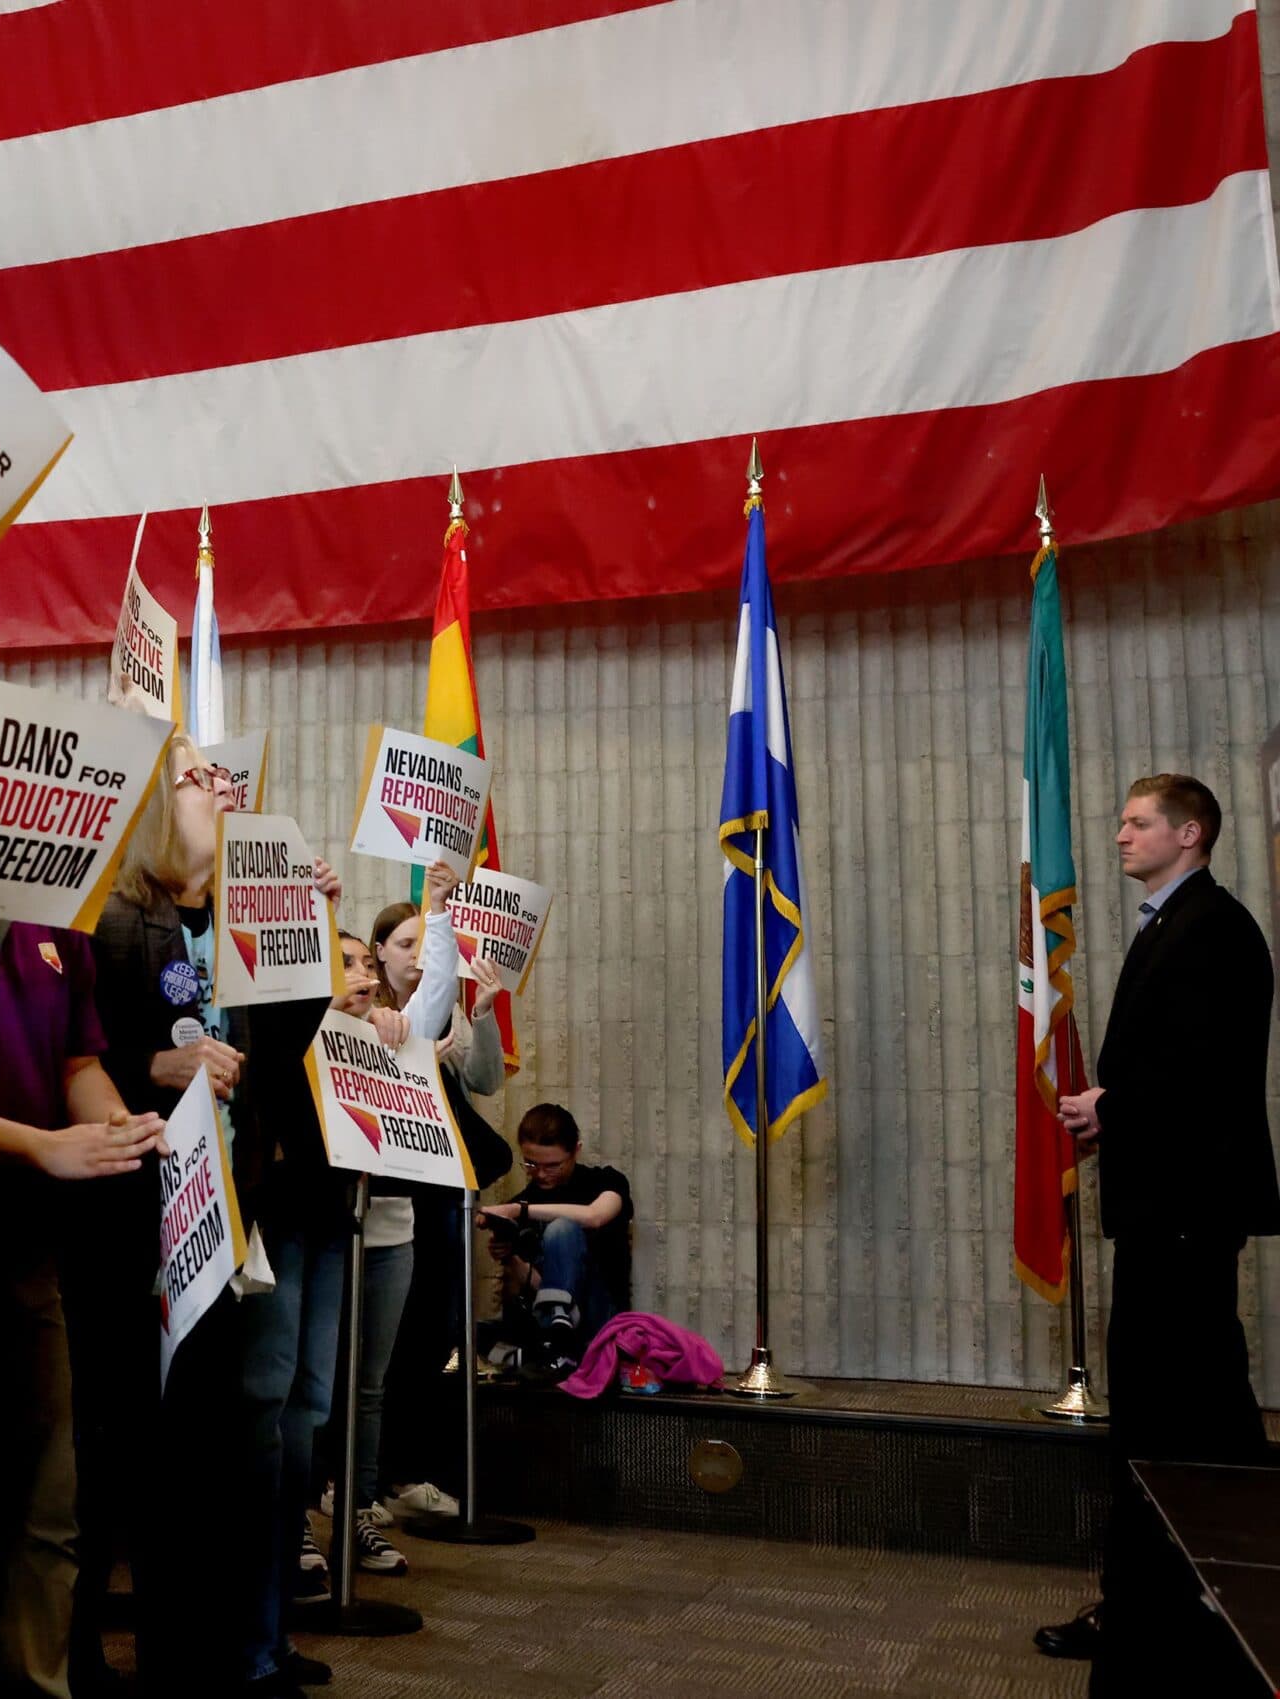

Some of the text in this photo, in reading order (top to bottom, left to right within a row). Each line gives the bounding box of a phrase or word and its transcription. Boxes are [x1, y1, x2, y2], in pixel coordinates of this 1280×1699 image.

[141, 621, 163, 648] FOR
[79, 765, 127, 790] FOR
[231, 770, 249, 784] OR
[385, 747, 480, 802] NEVADANS FOR
[380, 777, 478, 830] REPRODUCTIVE
[425, 817, 473, 859] FREEDOM
[227, 840, 312, 879] NEVADANS FOR
[228, 885, 317, 924] REPRODUCTIVE
[522, 911, 538, 924] FOR
[446, 903, 535, 950] EPRODUCTIVE
[260, 927, 322, 967] FREEDOM
[482, 938, 528, 973] FREEDOM
[173, 963, 195, 978] KEEP
[321, 1030, 430, 1088] NEVADANS FOR
[330, 1066, 442, 1122] REPRODUCTIVE
[184, 1135, 207, 1176] FOR
[380, 1114, 454, 1158] FREEDOM
